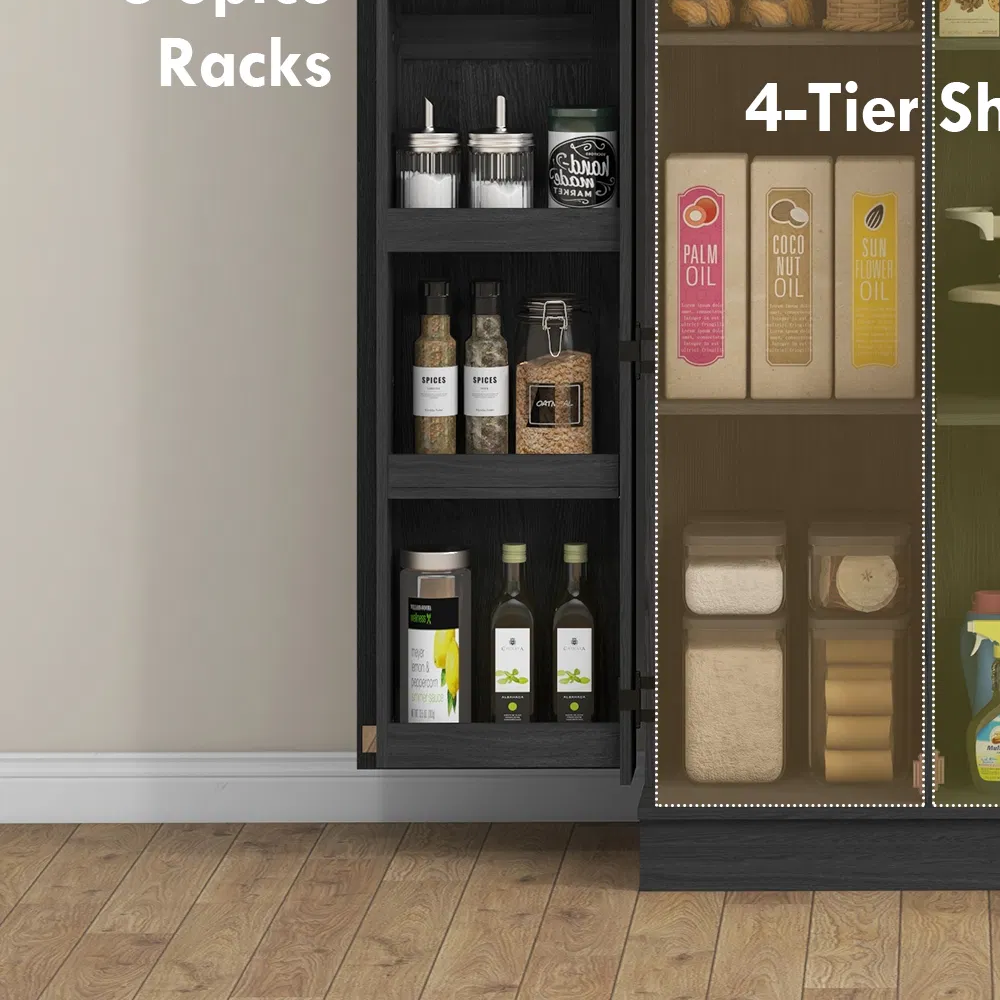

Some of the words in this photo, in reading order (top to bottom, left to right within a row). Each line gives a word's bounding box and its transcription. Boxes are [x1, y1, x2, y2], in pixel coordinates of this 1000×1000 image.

[683, 244, 718, 264] PALM
[773, 234, 805, 255] COCO
[862, 237, 887, 258] SUN
[686, 265, 717, 287] OIL
[776, 256, 801, 276] NUT
[855, 259, 893, 279] FLOWER
[774, 277, 804, 298] OIL
[860, 280, 890, 301] OIL
[421, 376, 447, 384] SPICES
[472, 376, 498, 384] SPICES
